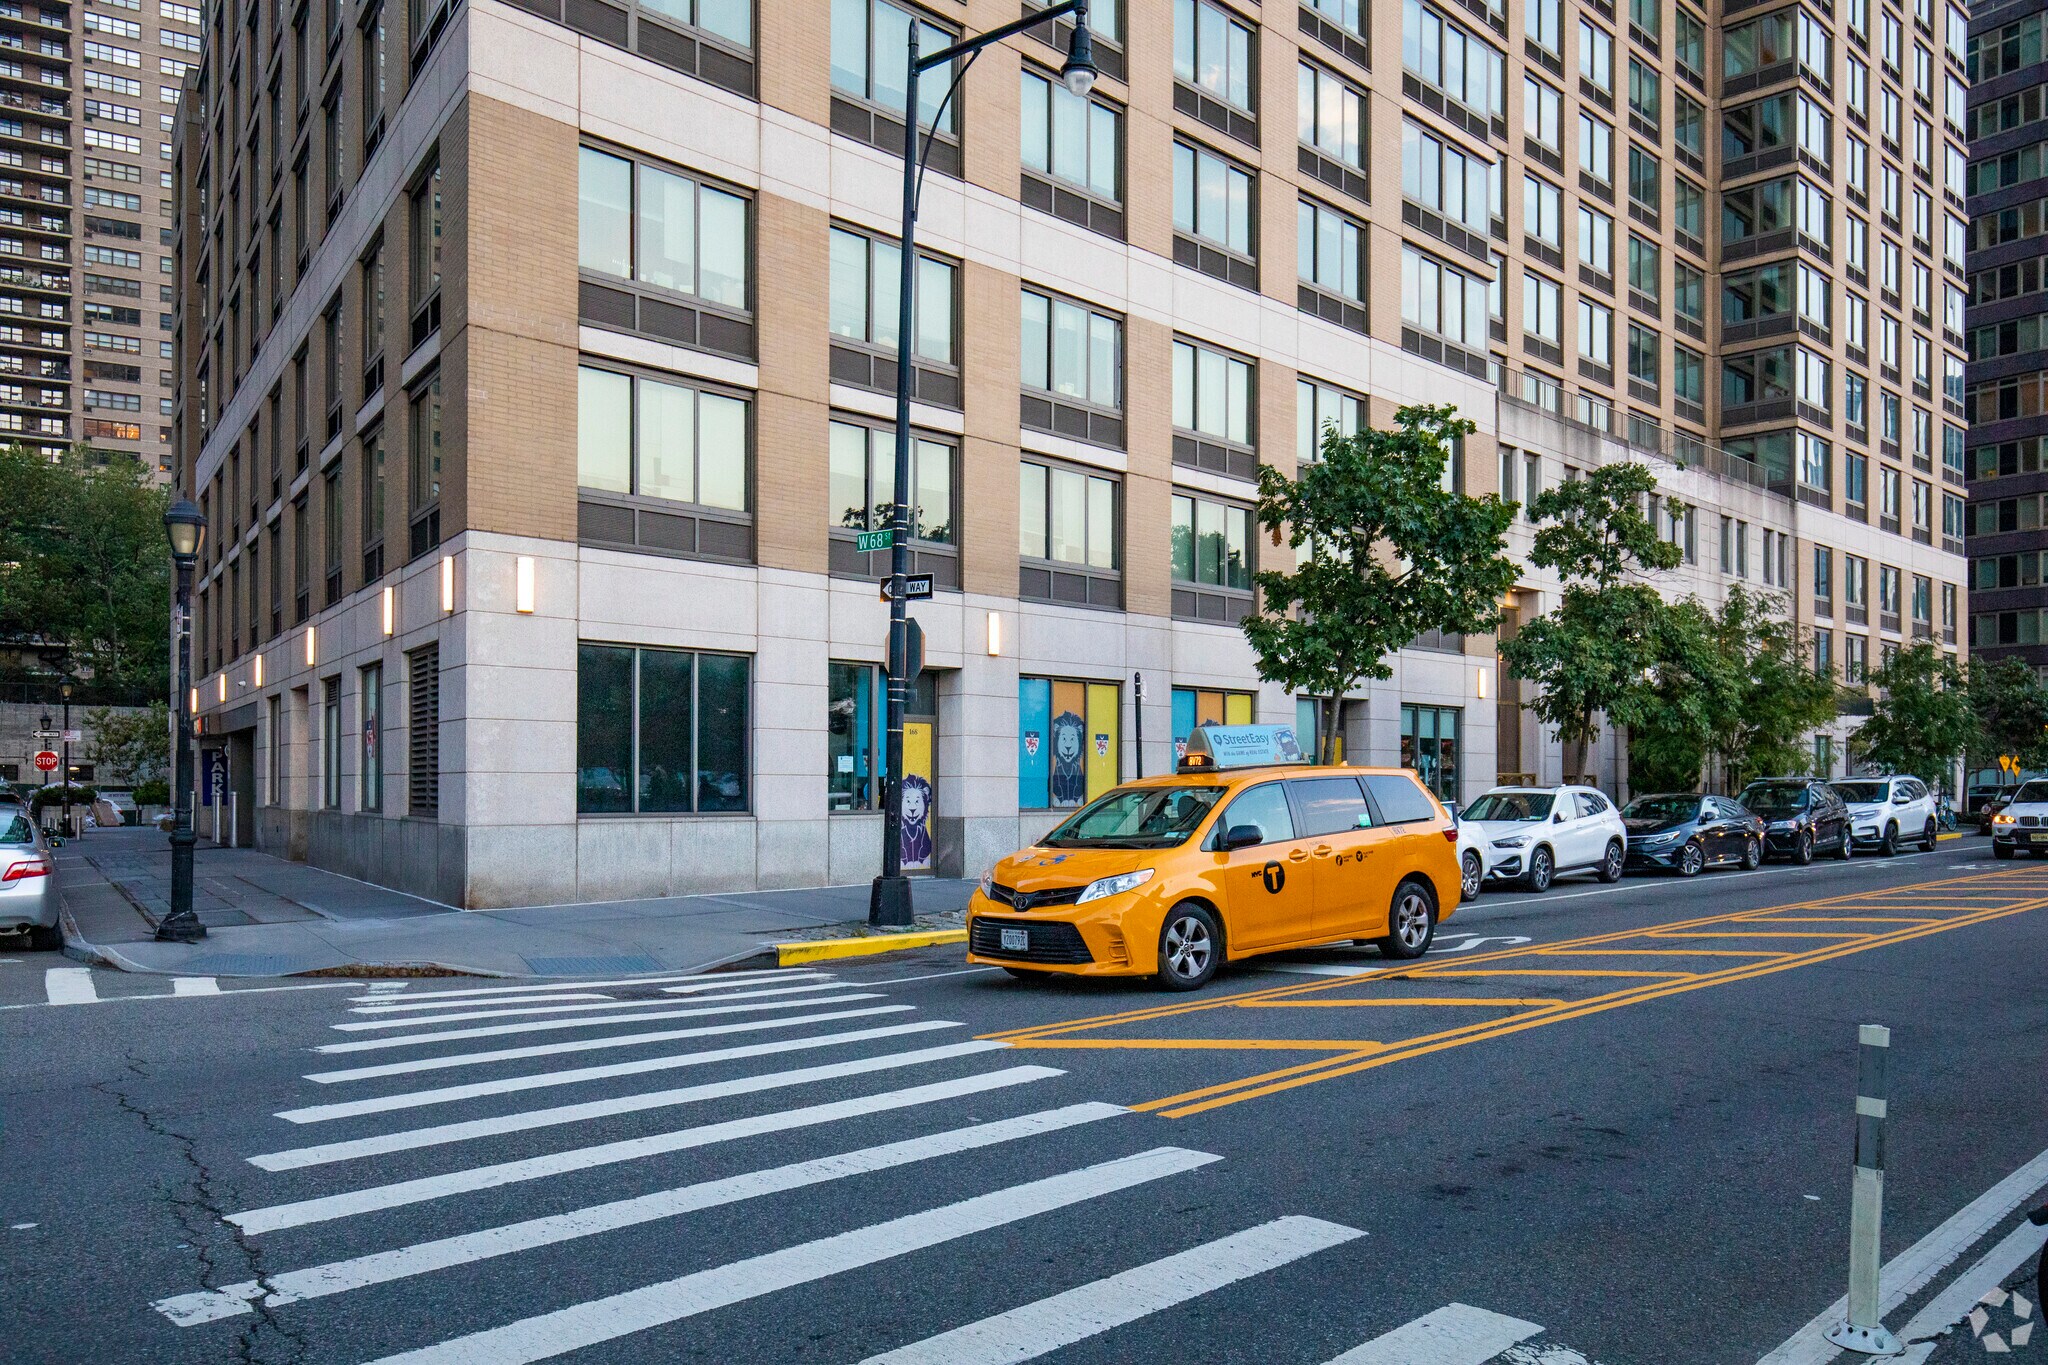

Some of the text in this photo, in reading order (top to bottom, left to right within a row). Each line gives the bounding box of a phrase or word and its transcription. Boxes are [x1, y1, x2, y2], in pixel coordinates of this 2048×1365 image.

[858, 534, 868, 549] W
[870, 533, 883, 548] 68
[909, 582, 926, 592] WAY
[1222, 734, 1270, 746] StreetEasy
[211, 751, 225, 796] PARK
[1251, 865, 1280, 890] NYC T
